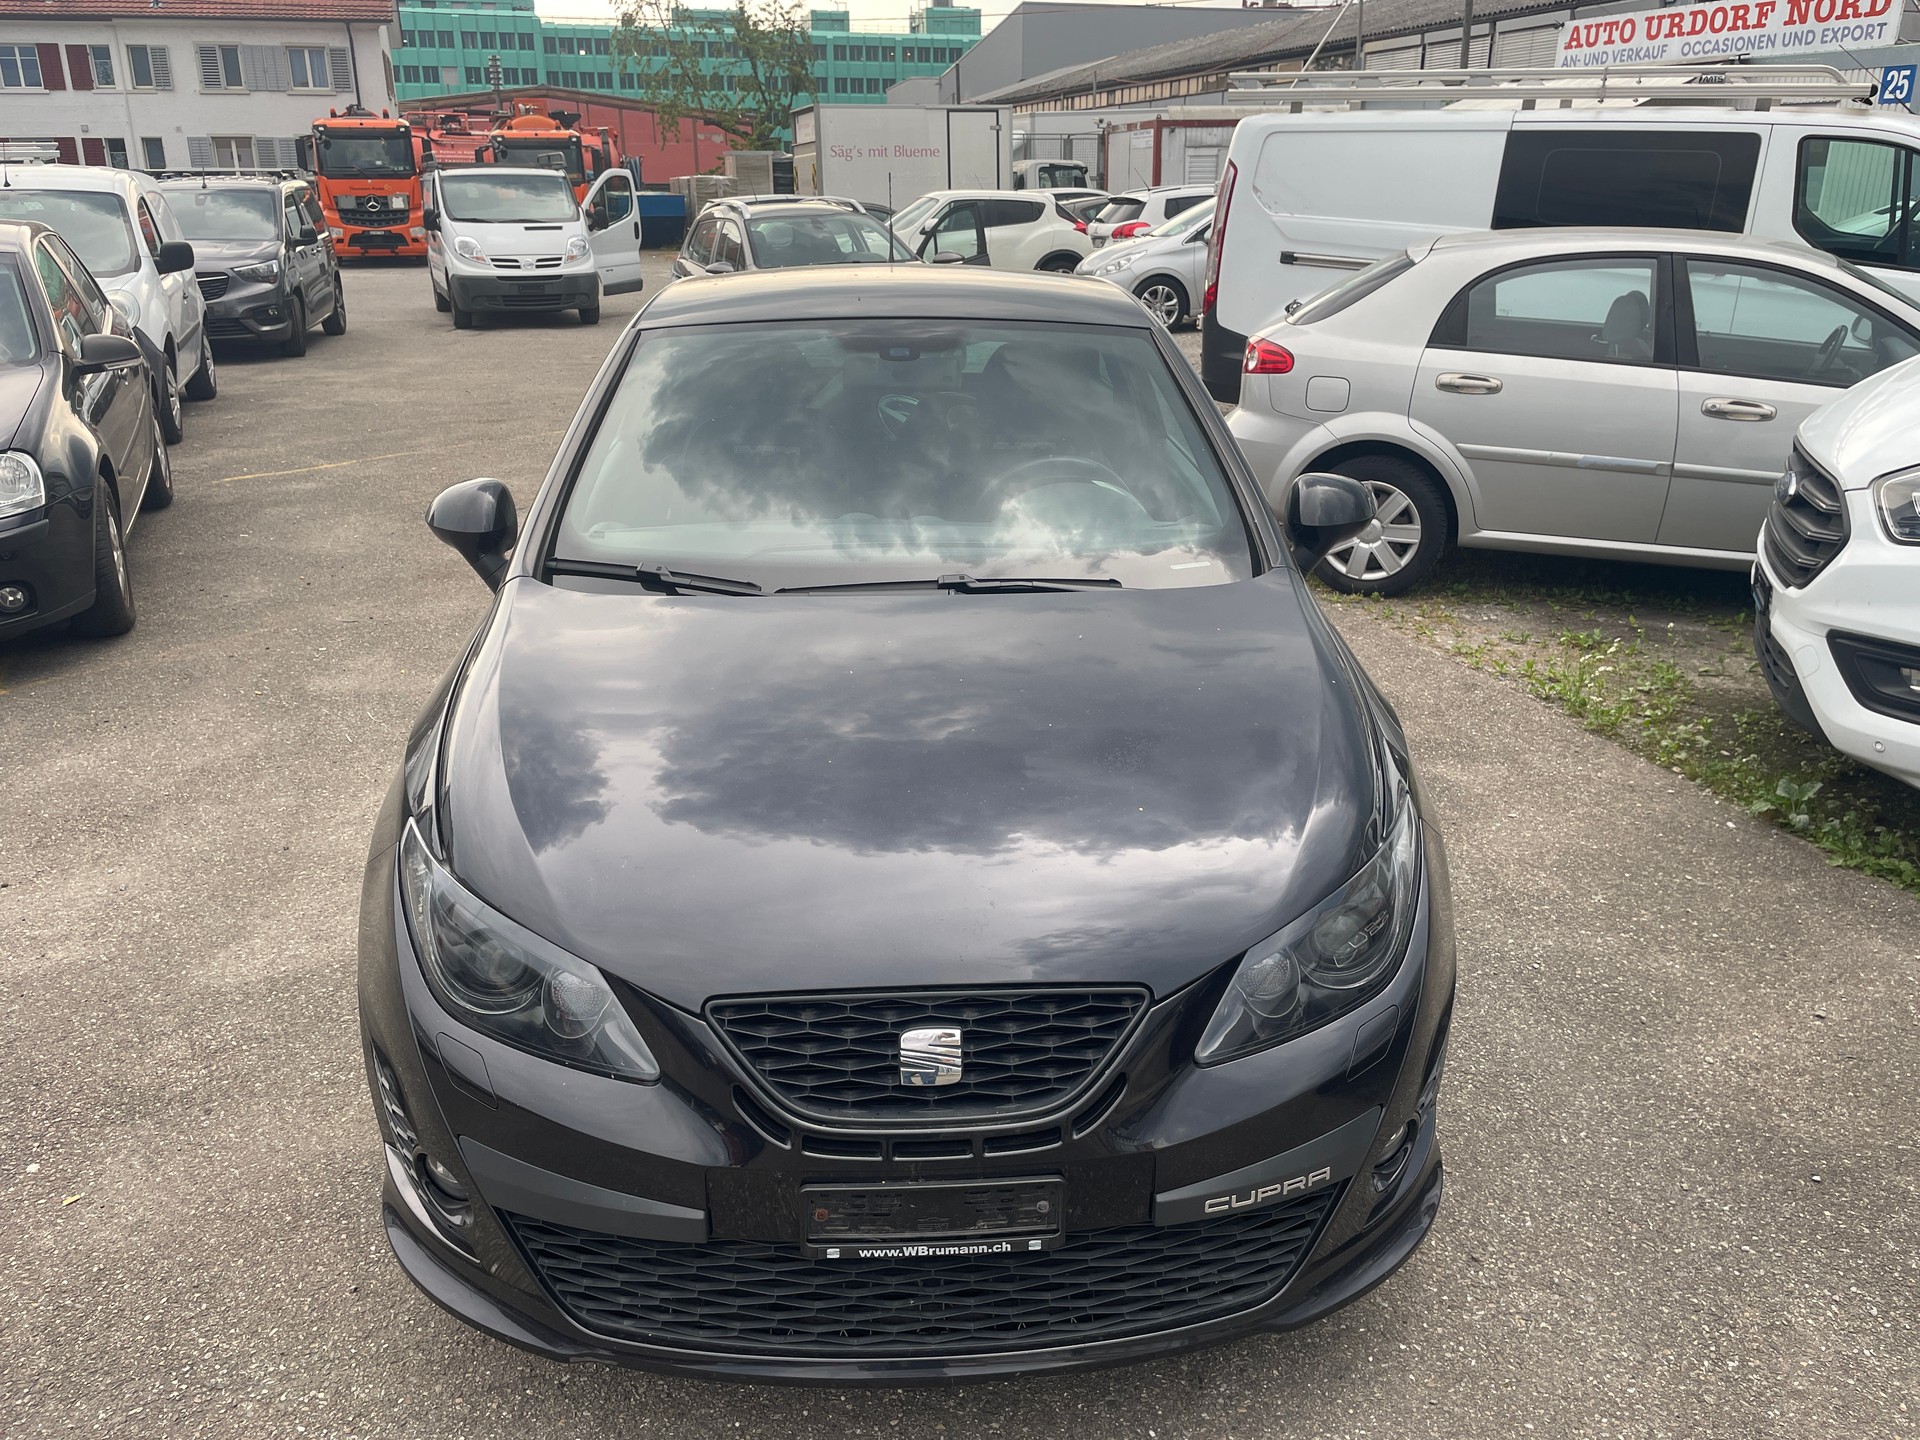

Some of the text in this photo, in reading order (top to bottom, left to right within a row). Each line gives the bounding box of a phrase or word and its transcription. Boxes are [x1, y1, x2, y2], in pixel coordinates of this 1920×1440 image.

[1564, 0, 1892, 50] AUTO URDORF NORD
[1561, 22, 1887, 68] AN- UND VERKAUF OCCASIONEN UND EXPORT
[1883, 69, 1912, 100] 25
[868, 145, 889, 158] mit
[894, 145, 941, 158] Blueme
[1204, 1166, 1331, 1213] CUPRA
[859, 1242, 1012, 1258] www.WBrumann.ch
